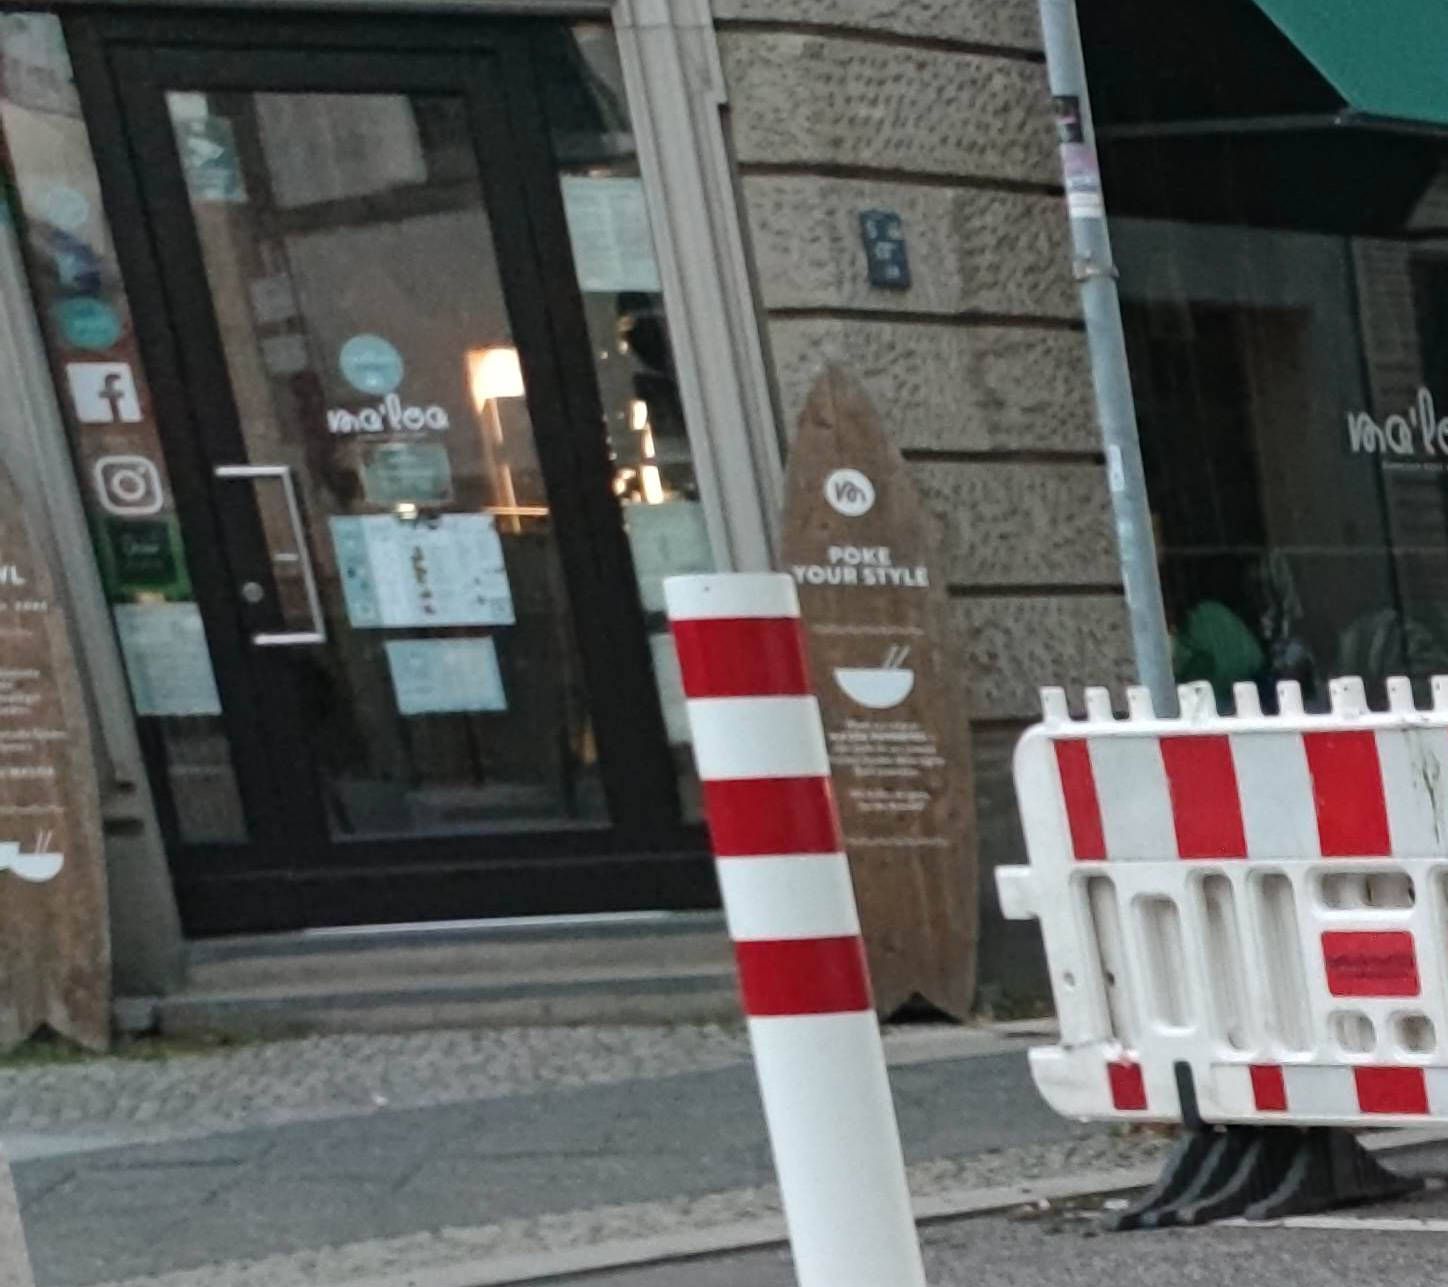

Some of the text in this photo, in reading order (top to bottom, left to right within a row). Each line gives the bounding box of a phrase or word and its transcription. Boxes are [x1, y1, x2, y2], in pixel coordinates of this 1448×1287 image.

[828, 545, 891, 567] POKE
[791, 565, 929, 588] YOUR STYLE
